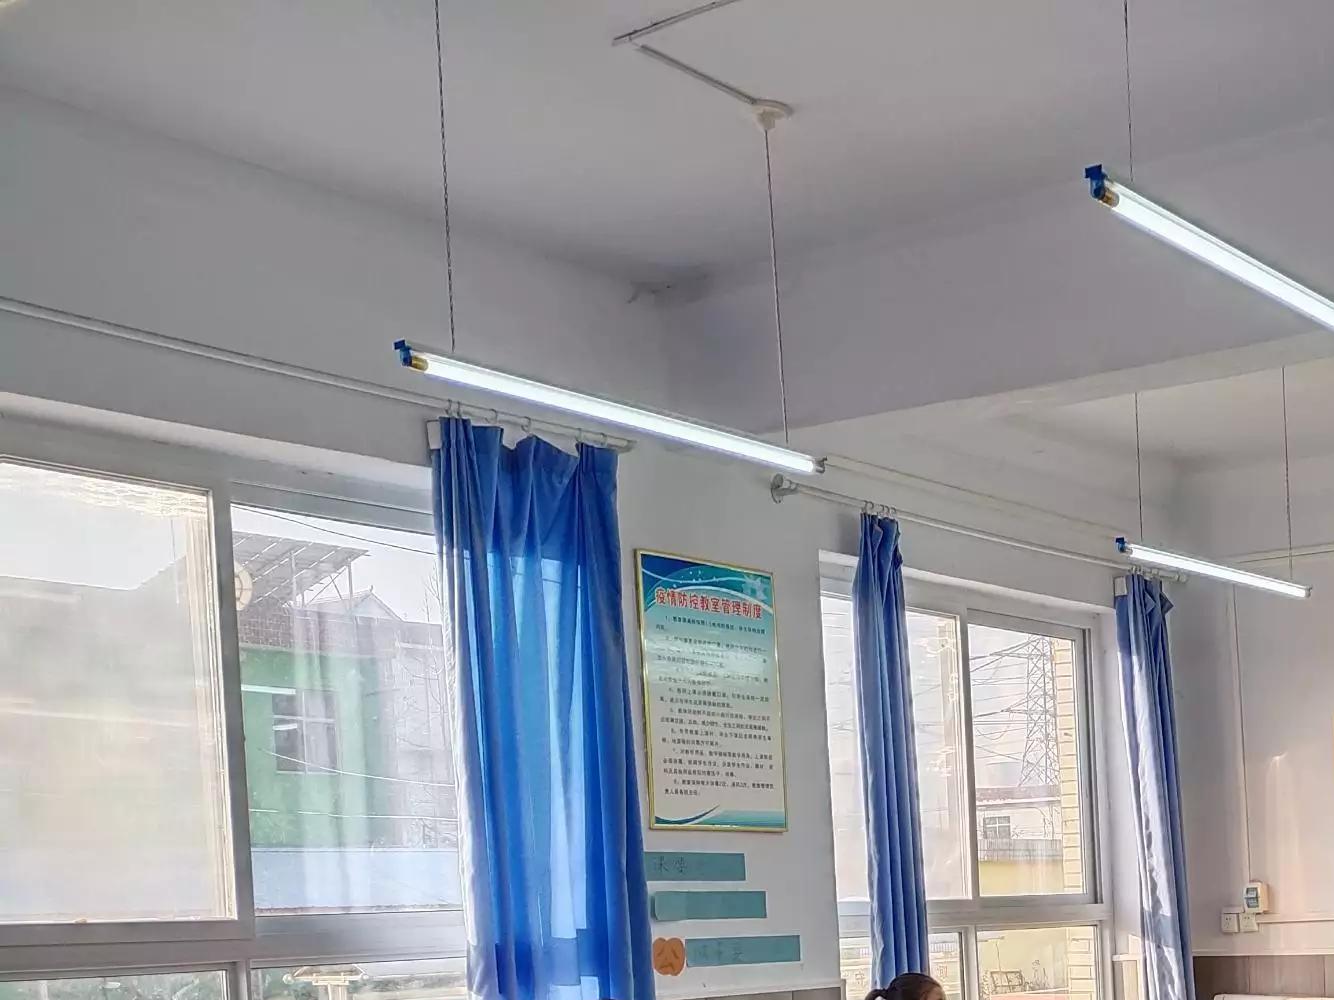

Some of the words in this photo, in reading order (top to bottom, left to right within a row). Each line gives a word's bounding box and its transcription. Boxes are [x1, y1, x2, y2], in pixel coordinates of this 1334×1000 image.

[655, 586, 763, 619] 疫情防控教室管理制度
